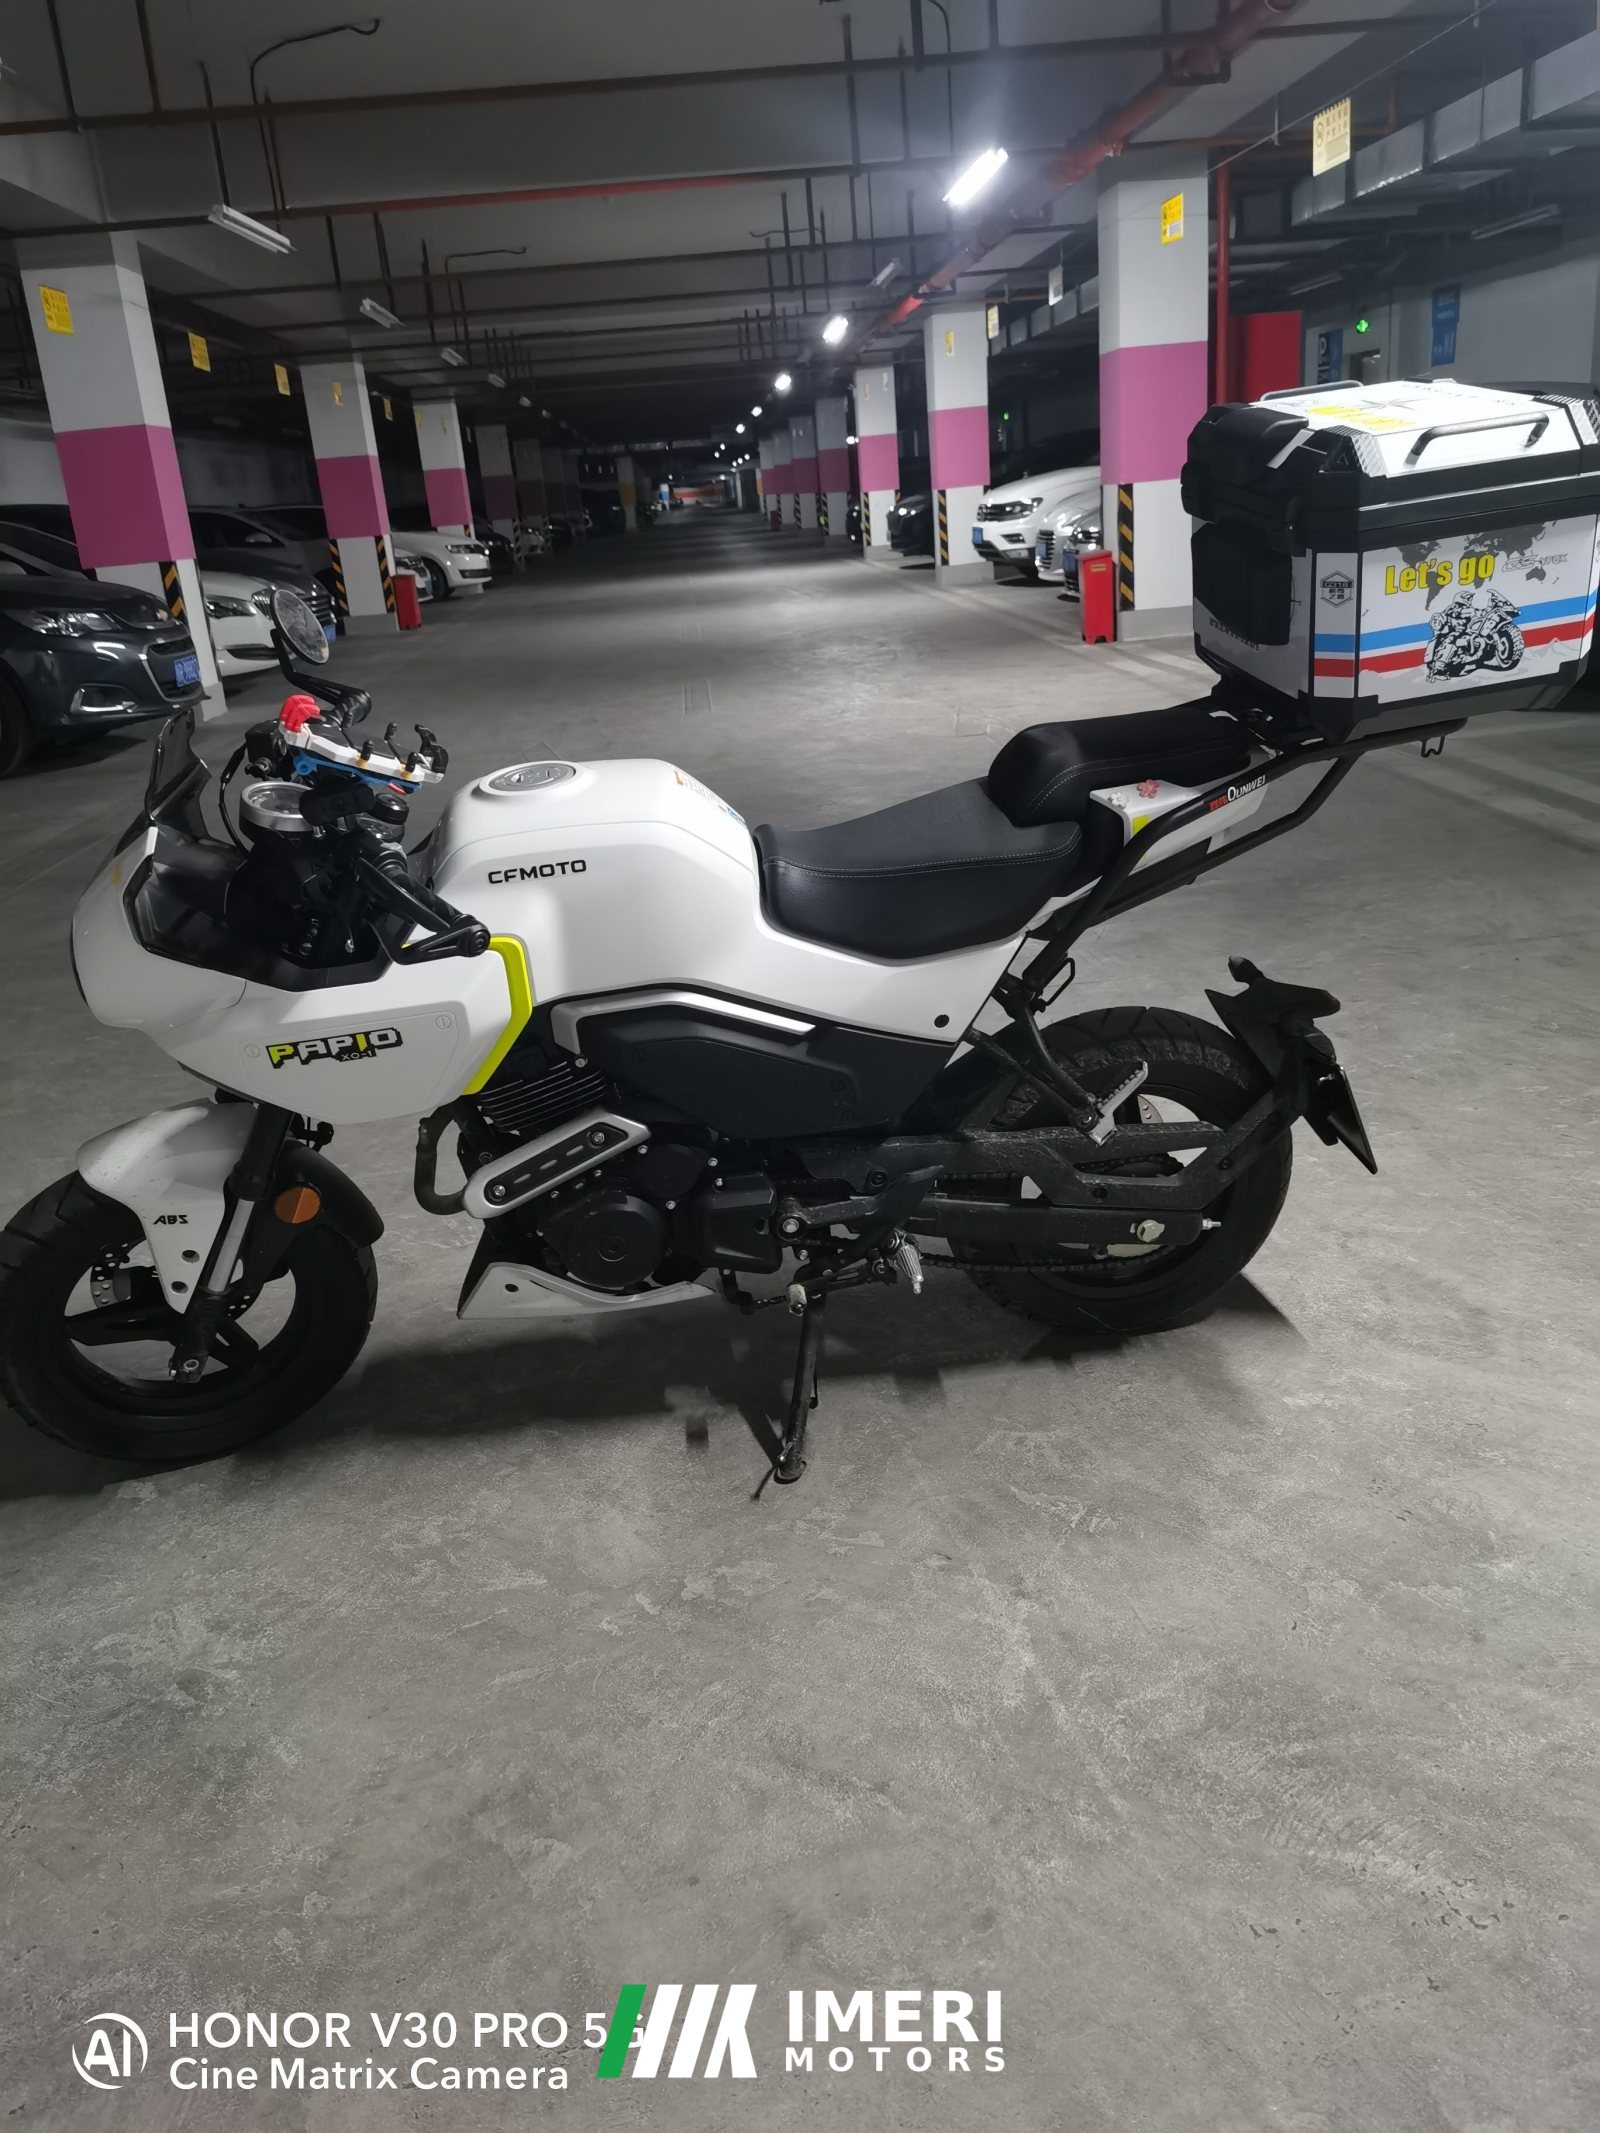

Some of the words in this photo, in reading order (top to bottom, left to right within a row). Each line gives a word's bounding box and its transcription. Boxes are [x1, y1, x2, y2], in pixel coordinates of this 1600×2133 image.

[1384, 558, 1453, 596] Let's
[1457, 553, 1495, 586] go
[488, 859, 587, 884] CFMOTO
[267, 1028, 402, 1067] PAPIO
[153, 1214, 189, 1225] ABS
